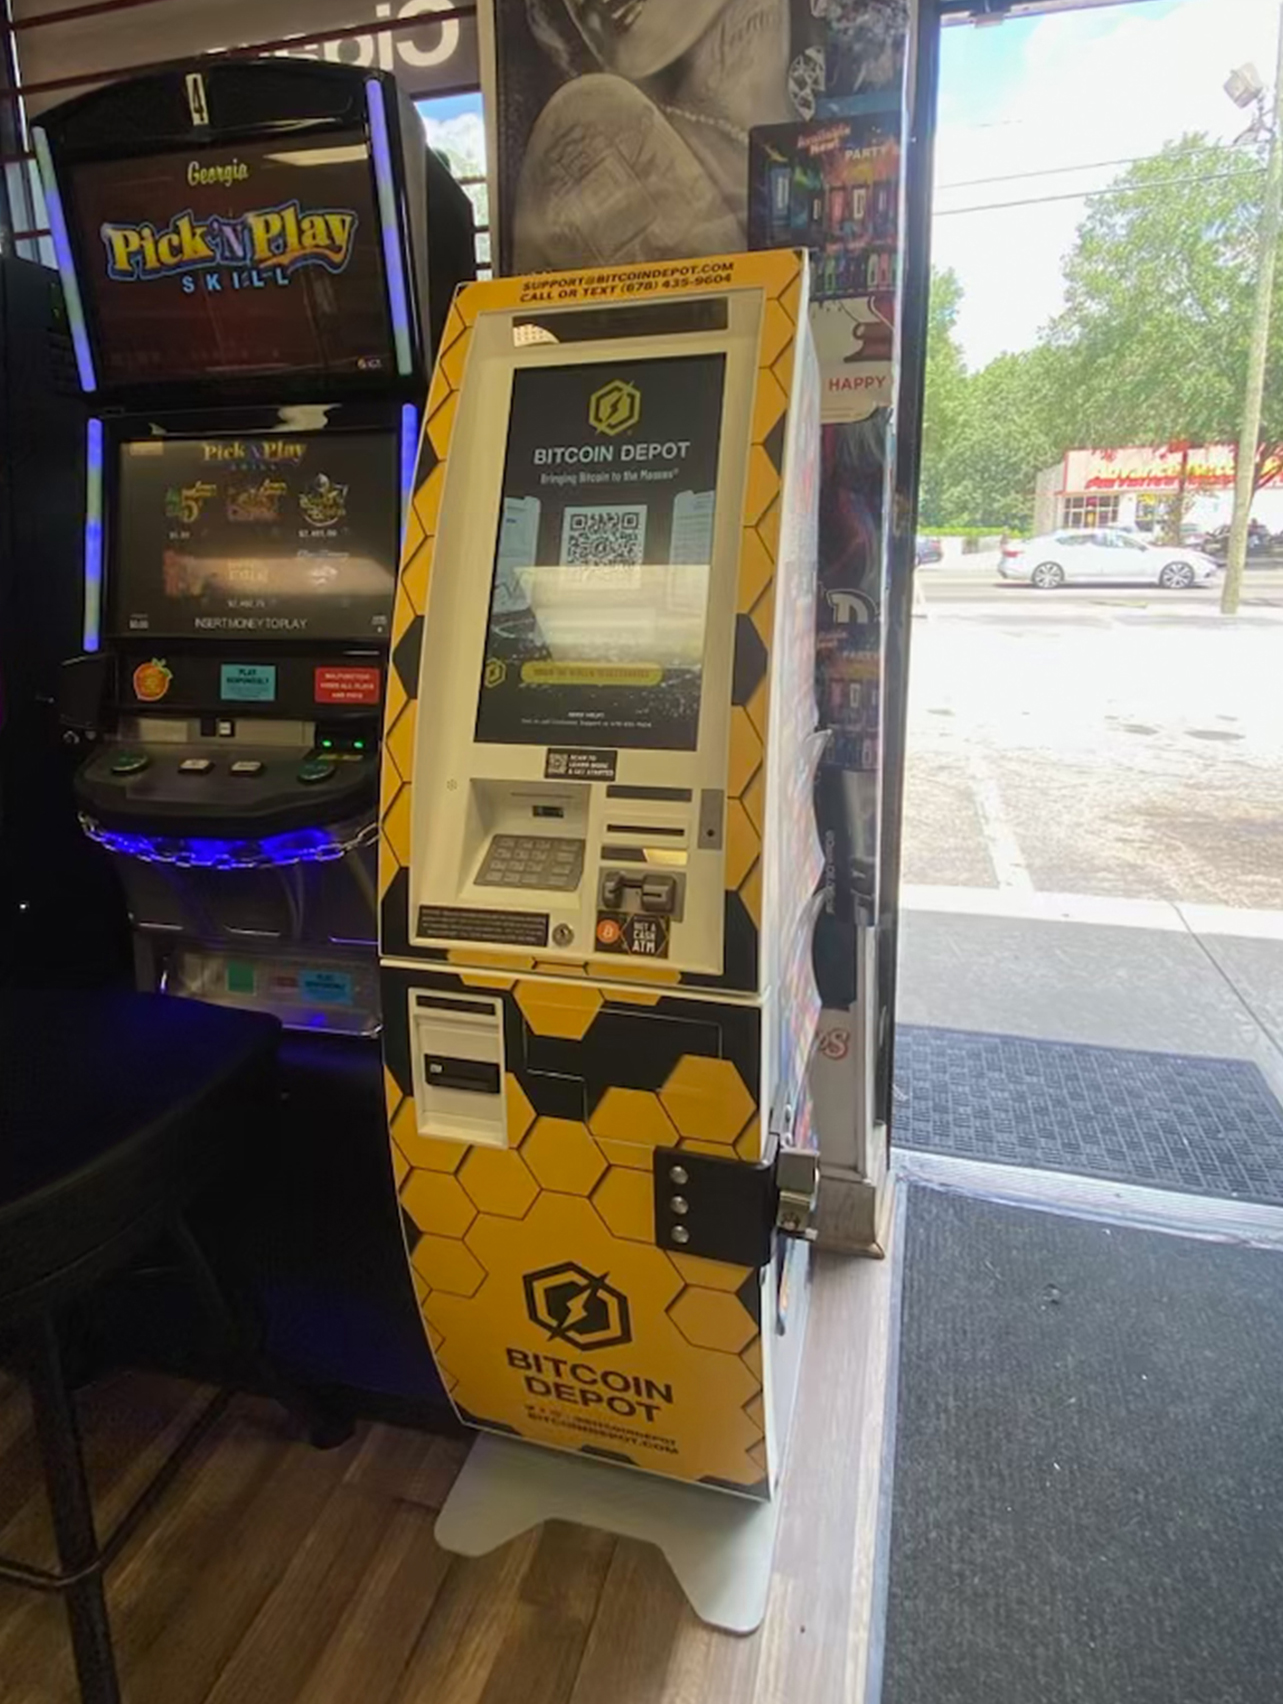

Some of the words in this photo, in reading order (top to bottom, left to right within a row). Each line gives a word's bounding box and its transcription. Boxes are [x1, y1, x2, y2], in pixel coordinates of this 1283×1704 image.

[187, 158, 249, 187] Georgia
[107, 211, 210, 276] Pick
[248, 202, 355, 268] Play
[182, 271, 290, 293] SKILL
[520, 291, 554, 303] CALL
[558, 288, 578, 299] OR
[583, 284, 618, 297] TEXT
[620, 280, 659, 293] (678)
[661, 272, 732, 290] 435-9604
[522, 261, 735, 292] SUPPORT@BITCOINDEPOT.COM
[828, 375, 887, 391] HAPPY
[202, 441, 246, 461] Pick
[261, 441, 307, 461] Play
[533, 445, 614, 465] BITCOIN
[620, 441, 690, 462] DEPOT
[540, 471, 577, 486] Bringing
[579, 470, 610, 482] Bitcoin
[194, 617, 226, 629] INSERT
[228, 617, 263, 629] MONEY
[265, 617, 279, 629] TO
[280, 617, 309, 629] PLAY
[631, 939, 656, 954] ATM
[506, 1347, 674, 1404] BITCOIN
[524, 1376, 662, 1422] DEPOT
